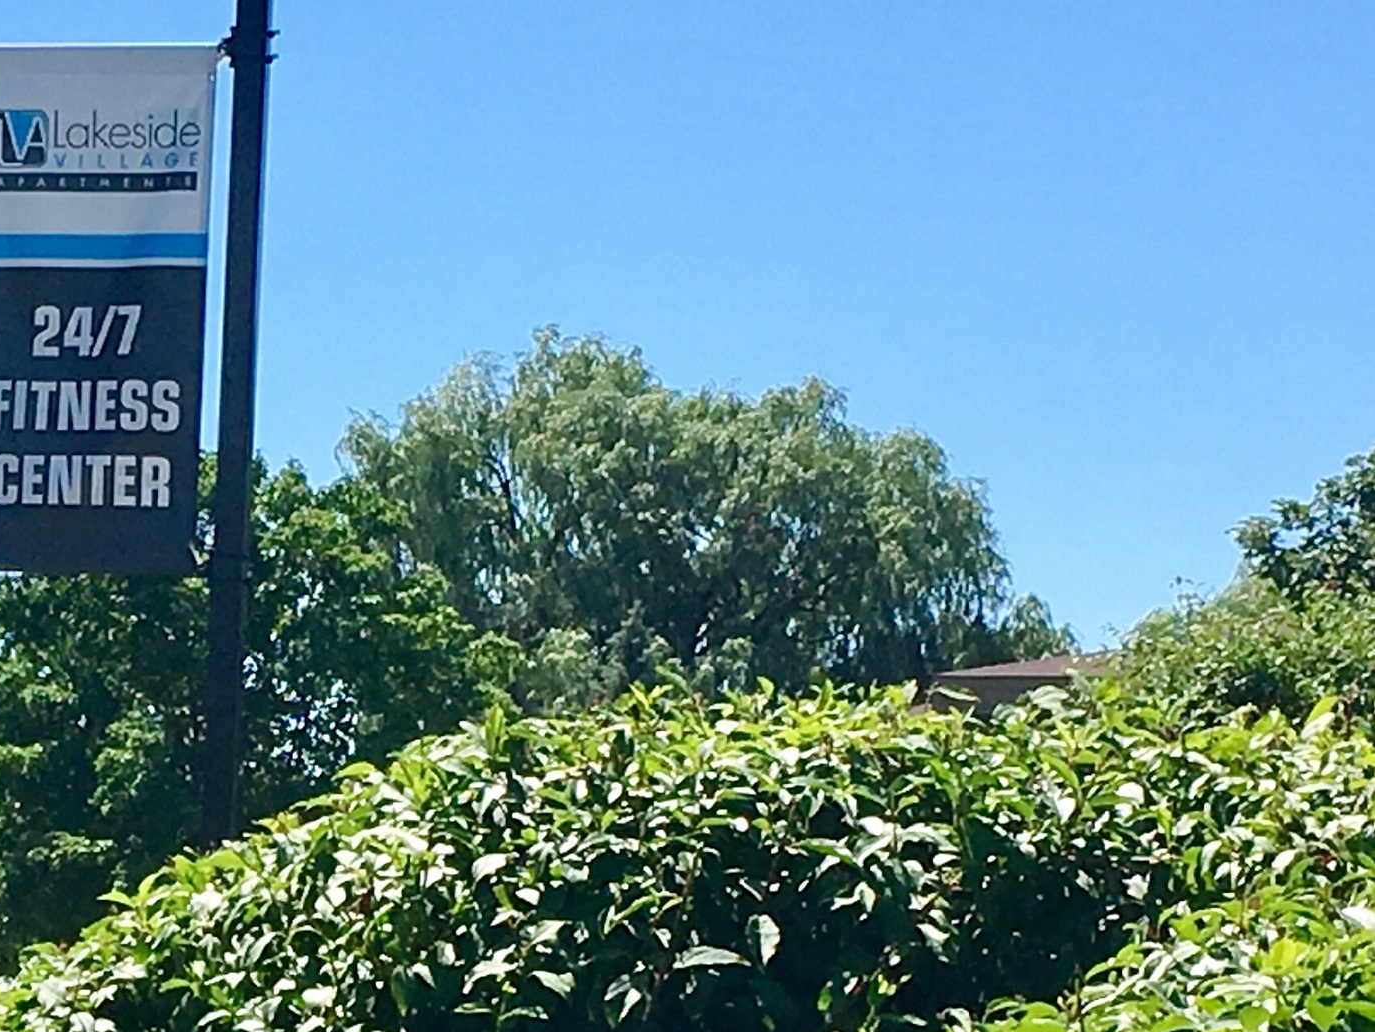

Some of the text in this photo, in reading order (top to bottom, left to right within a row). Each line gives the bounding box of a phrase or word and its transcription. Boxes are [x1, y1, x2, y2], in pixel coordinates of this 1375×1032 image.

[54, 109, 201, 149] Lakeside
[54, 152, 198, 169] VILLAGE
[31, 304, 142, 357] 24/7
